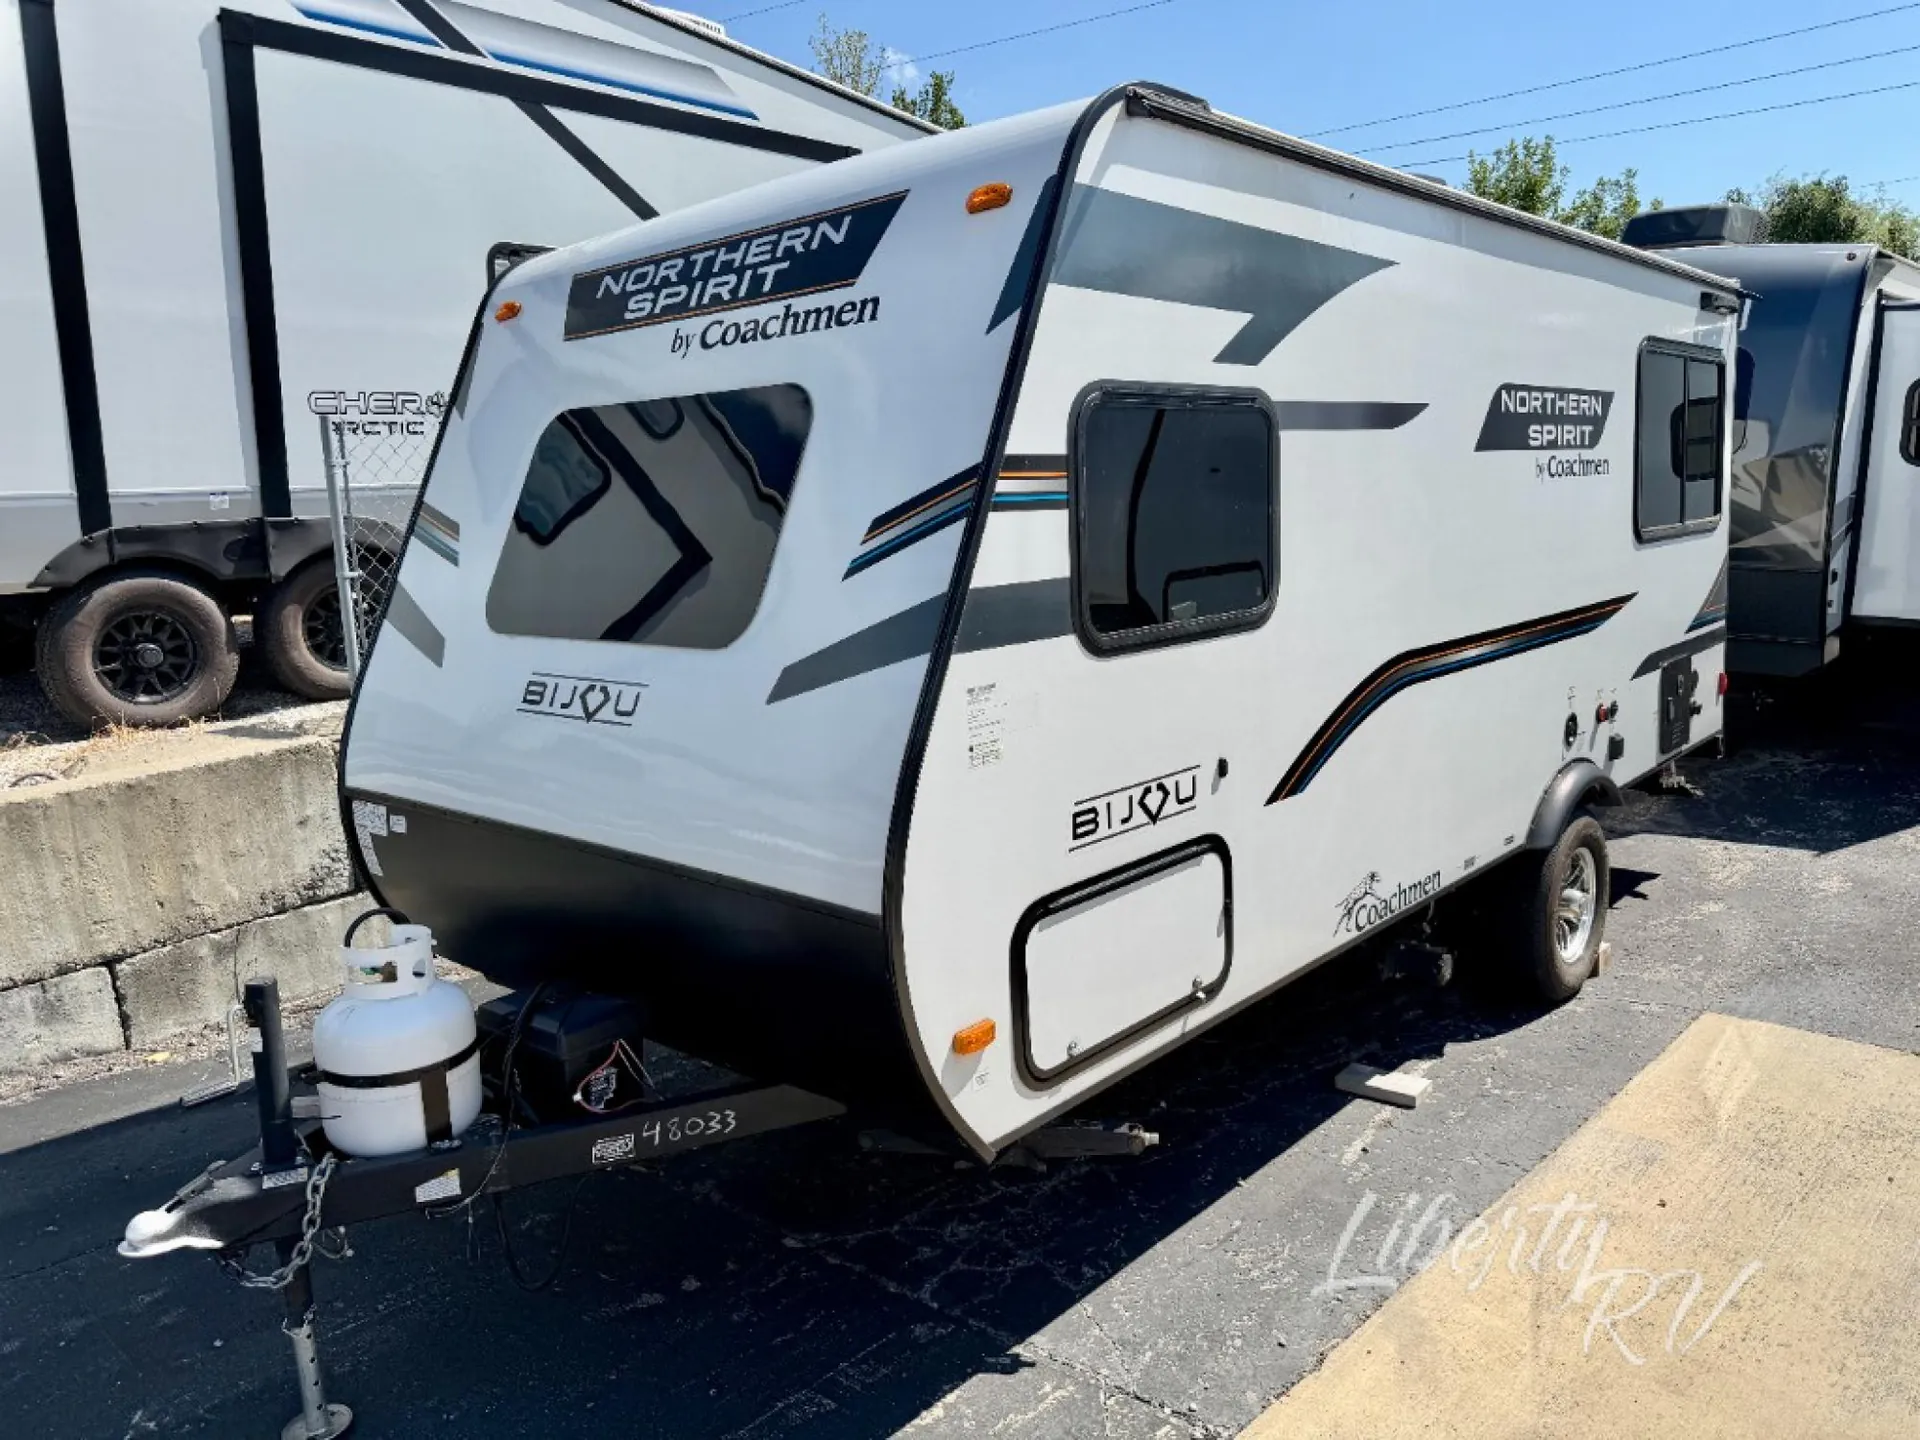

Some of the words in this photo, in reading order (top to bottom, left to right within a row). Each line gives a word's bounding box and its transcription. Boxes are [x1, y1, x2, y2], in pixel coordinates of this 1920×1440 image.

[596, 214, 853, 299] NORTHERN
[624, 260, 790, 320] SPIRIT
[671, 327, 697, 360] by
[699, 295, 881, 352] Coachmen
[1501, 388, 1603, 417] NORTHERN
[1527, 424, 1595, 447] SPIRIT
[1547, 452, 1610, 479] Coachmen
[521, 679, 642, 723] BIJOU
[1071, 774, 1198, 841] BIJOU
[1354, 869, 1442, 933] Coachmen
[642, 1108, 737, 1147] 48033
